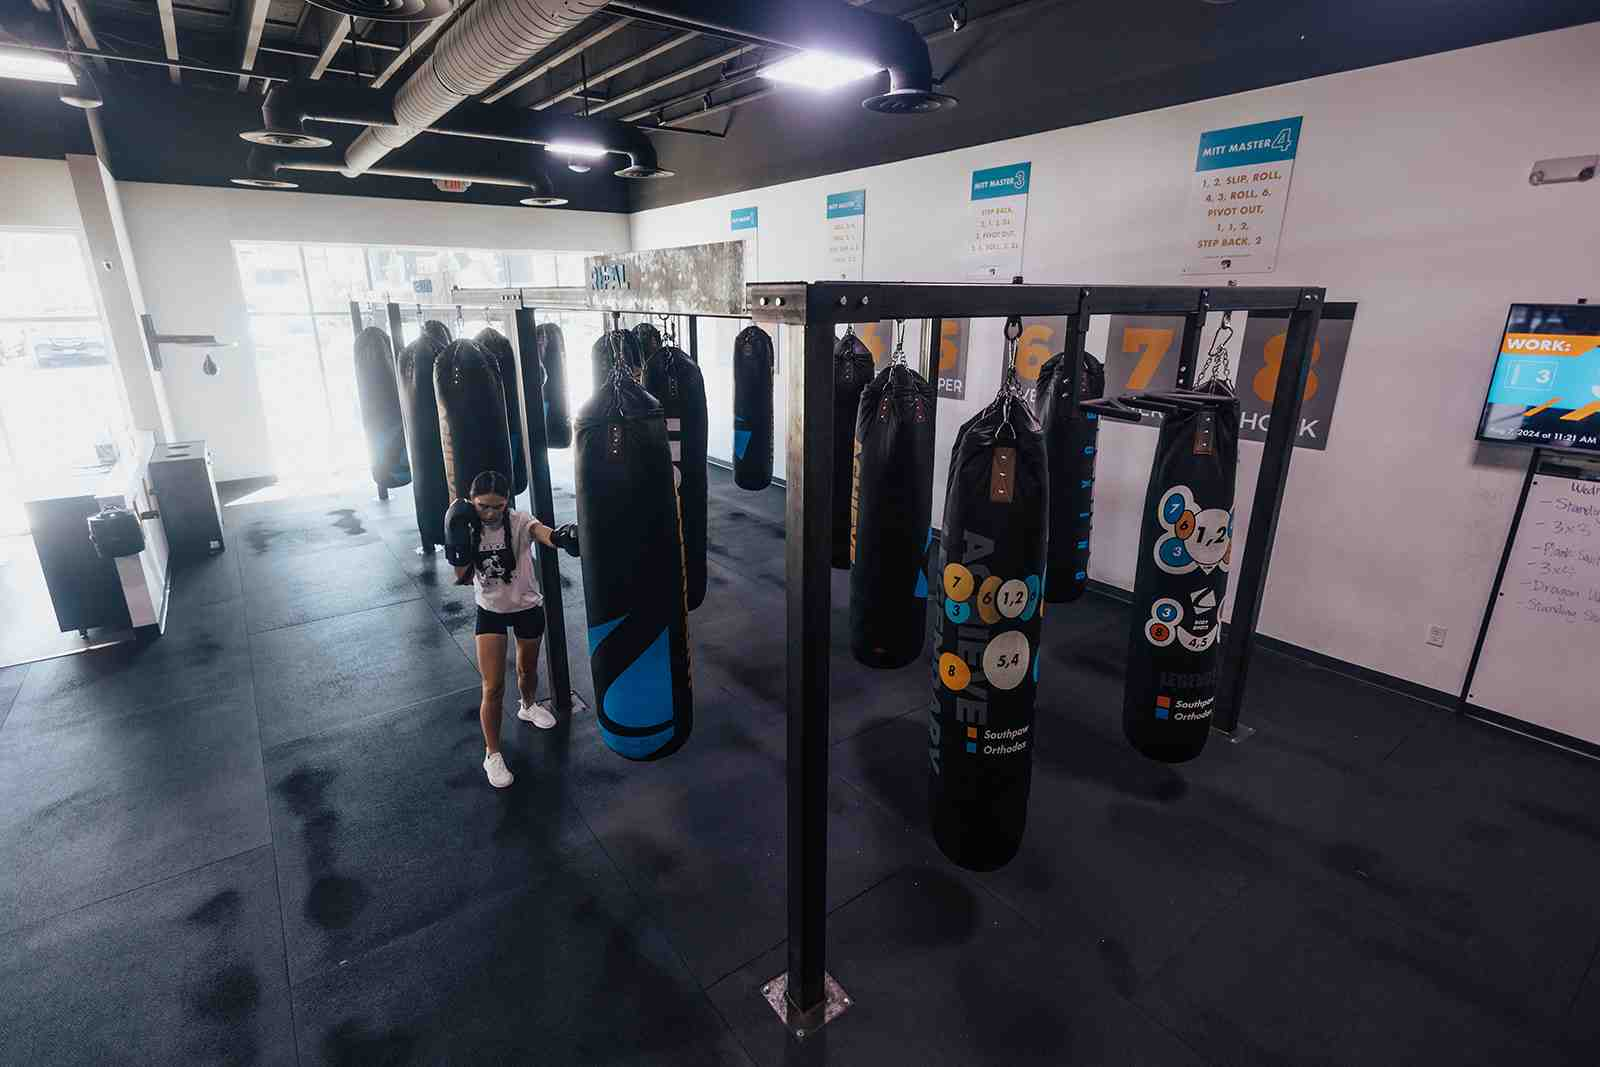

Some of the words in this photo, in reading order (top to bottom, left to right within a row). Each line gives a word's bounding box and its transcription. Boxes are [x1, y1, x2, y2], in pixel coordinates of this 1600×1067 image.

[1202, 145, 1226, 158] MITT
[1228, 138, 1272, 154] MASTER
[1271, 127, 1292, 152] 4
[1014, 170, 1025, 190] 3
[1202, 179, 1210, 189] 1,
[1253, 171, 1282, 183] ROLL,
[1207, 206, 1238, 217] PIVOT
[1240, 204, 1265, 216] OUT,
[1197, 238, 1219, 249] STEP
[1506, 337, 1573, 353] WORK:
[1122, 327, 1176, 390] 7
[1252, 330, 1321, 406] 8
[1239, 412, 1321, 443] HOK
[1517, 429, 1540, 438] 2024
[1553, 432, 1576, 442] 11:21
[1579, 435, 1598, 444] AM
[1168, 502, 1180, 515] 7
[1180, 520, 1189, 532] 6
[1196, 525, 1227, 547] 1,2
[1172, 547, 1182, 558] 3
[951, 575, 961, 589] 7
[982, 591, 993, 605] 6
[1002, 590, 1025, 608] 1,2
[952, 604, 961, 616] 3
[1162, 607, 1172, 618] 3
[1187, 636, 1208, 650] 4,5
[996, 652, 1020, 670] 5,4
[947, 664, 956, 677] 8
[984, 725, 1030, 741] Southpaw
